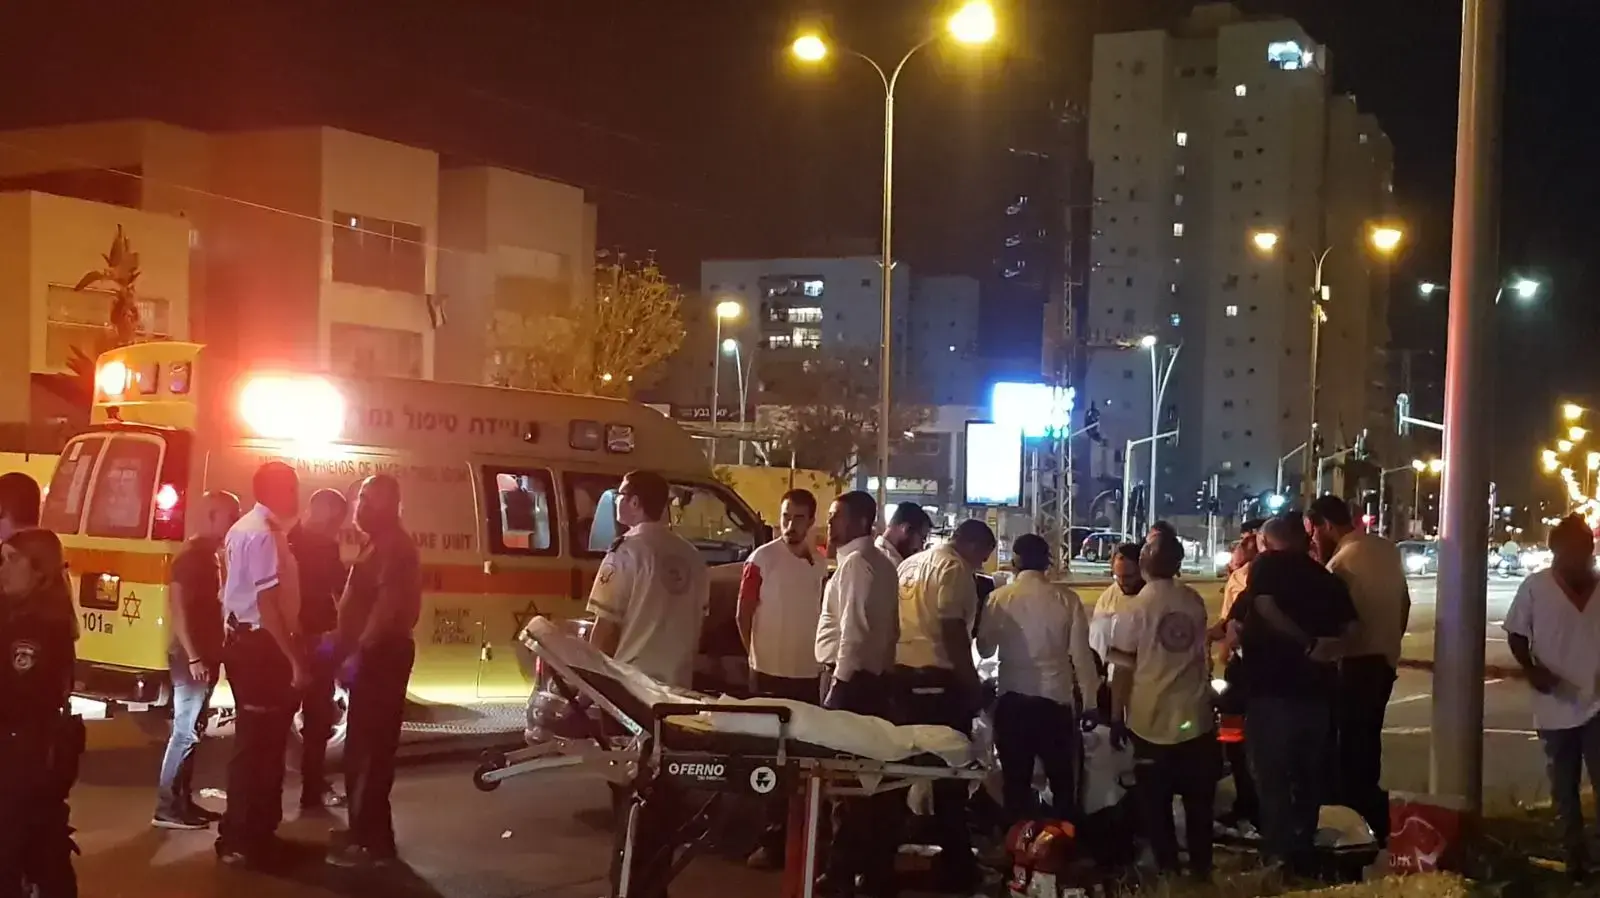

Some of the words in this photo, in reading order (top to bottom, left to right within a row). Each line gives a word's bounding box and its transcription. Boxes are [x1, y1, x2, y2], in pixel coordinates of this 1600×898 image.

[403, 403, 458, 433] טיפול
[358, 461, 372, 477] OF
[408, 532, 437, 549] ARE
[82, 611, 103, 633] 101
[680, 763, 725, 776] FERNO
